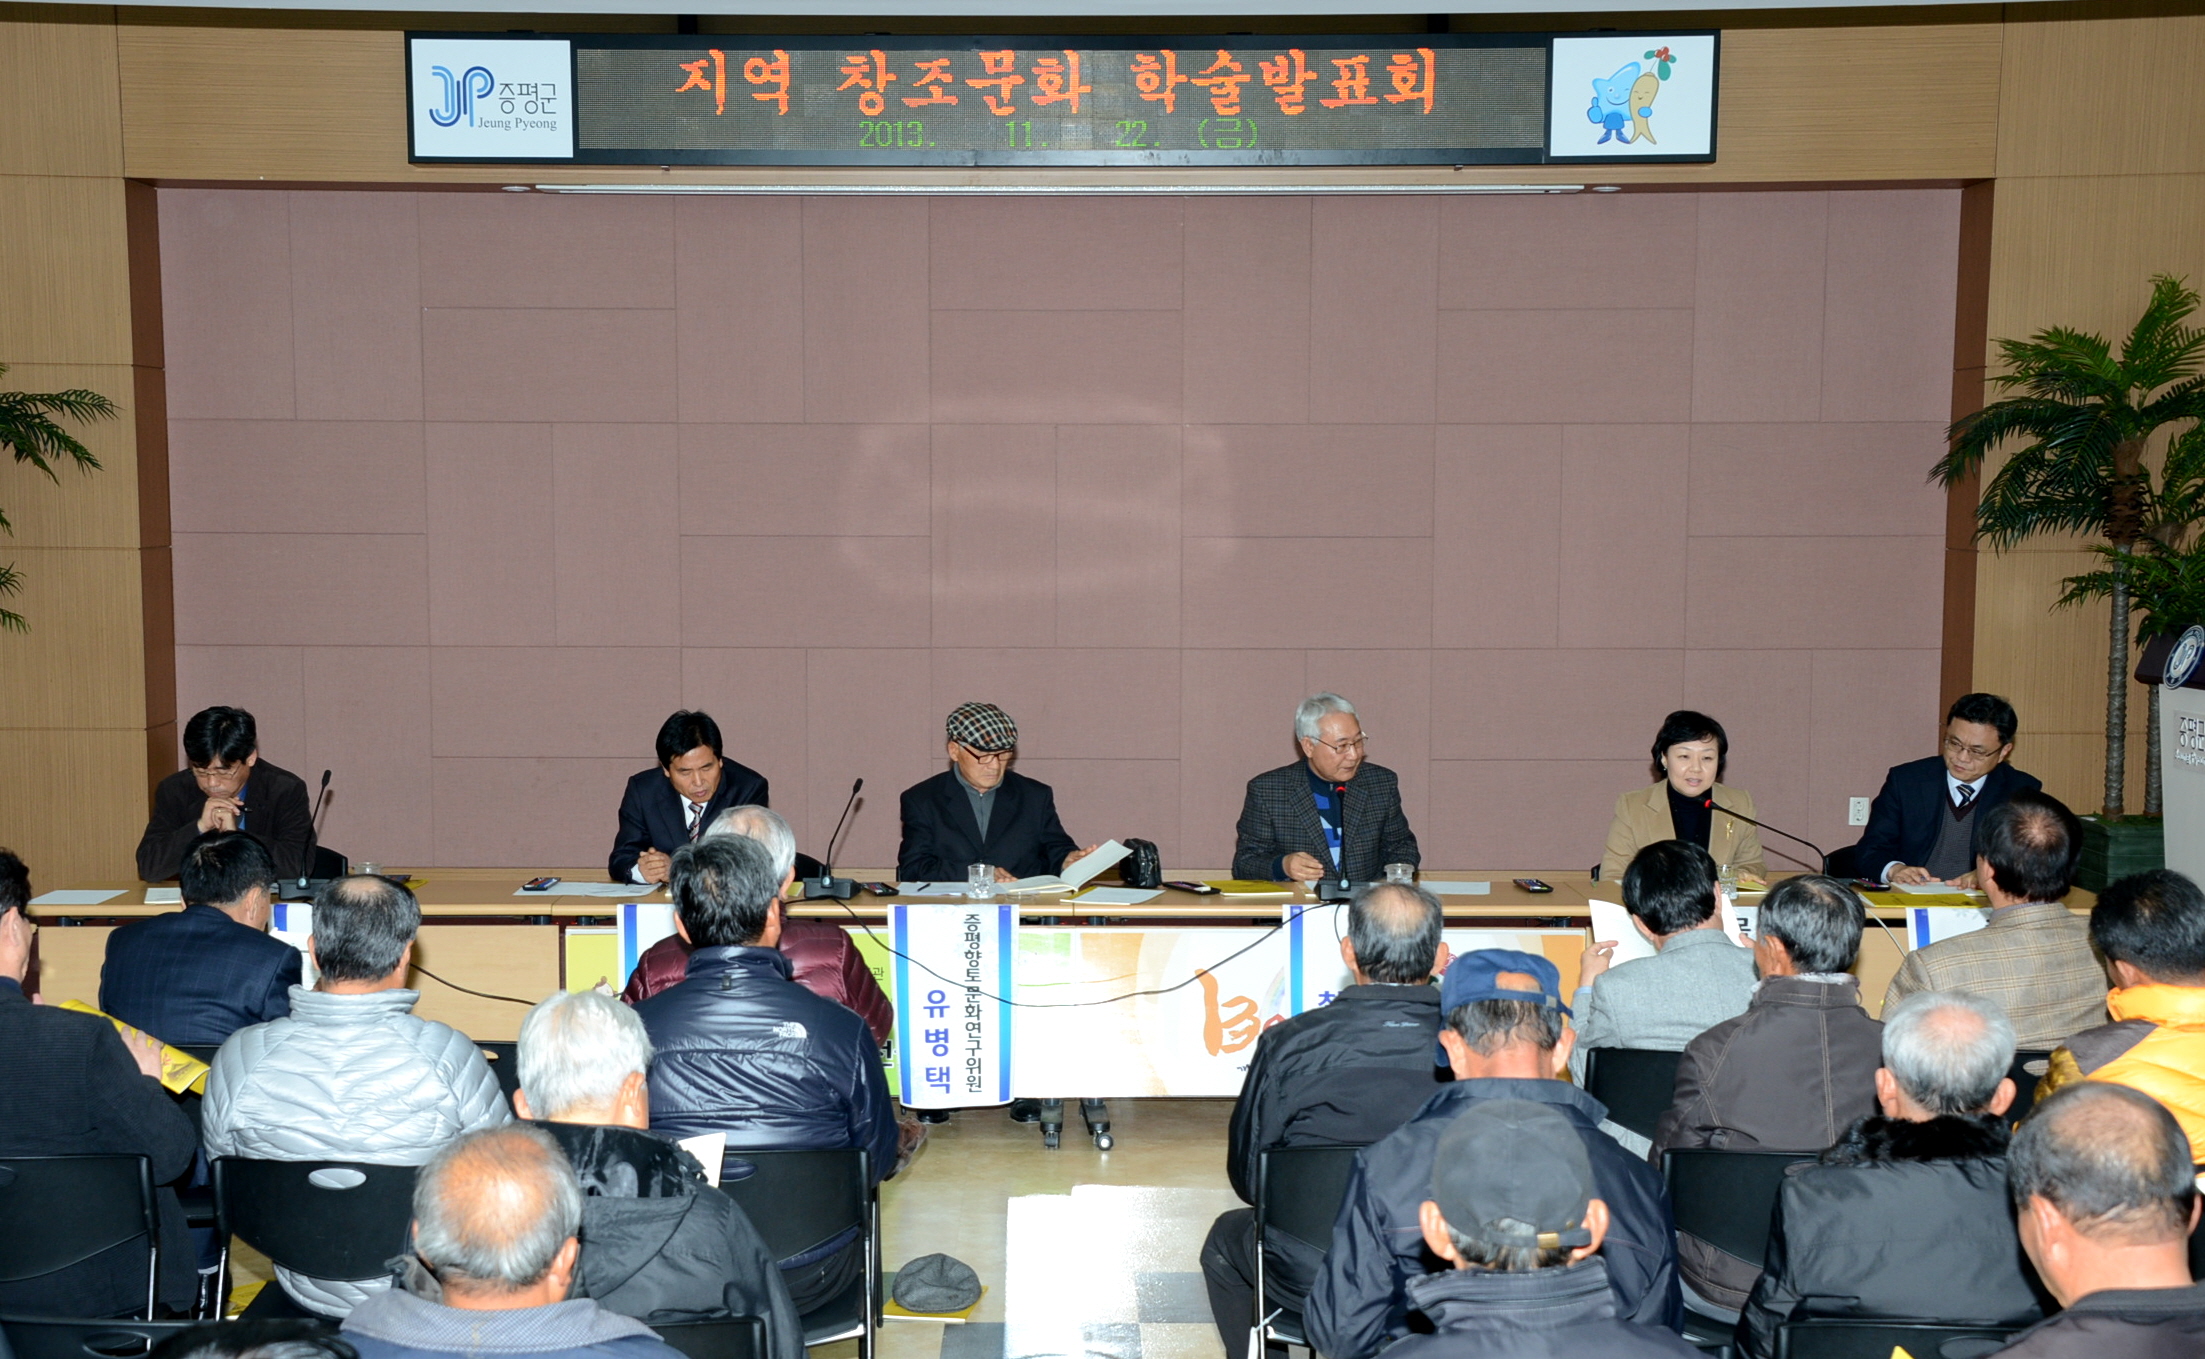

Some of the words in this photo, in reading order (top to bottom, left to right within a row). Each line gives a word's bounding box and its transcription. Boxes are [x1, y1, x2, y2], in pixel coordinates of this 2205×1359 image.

[675, 49, 790, 115] 지역
[836, 49, 1092, 115] 창조문화
[1130, 48, 1435, 115] 학술발표회
[499, 83, 557, 114] 증평군
[478, 117, 511, 131] Jeung
[515, 117, 557, 131] Pyeong
[858, 121, 936, 147] 2013.
[1006, 121, 1048, 147] 11.
[1115, 120, 1160, 147] 22.
[1198, 118, 1258, 148] (금)
